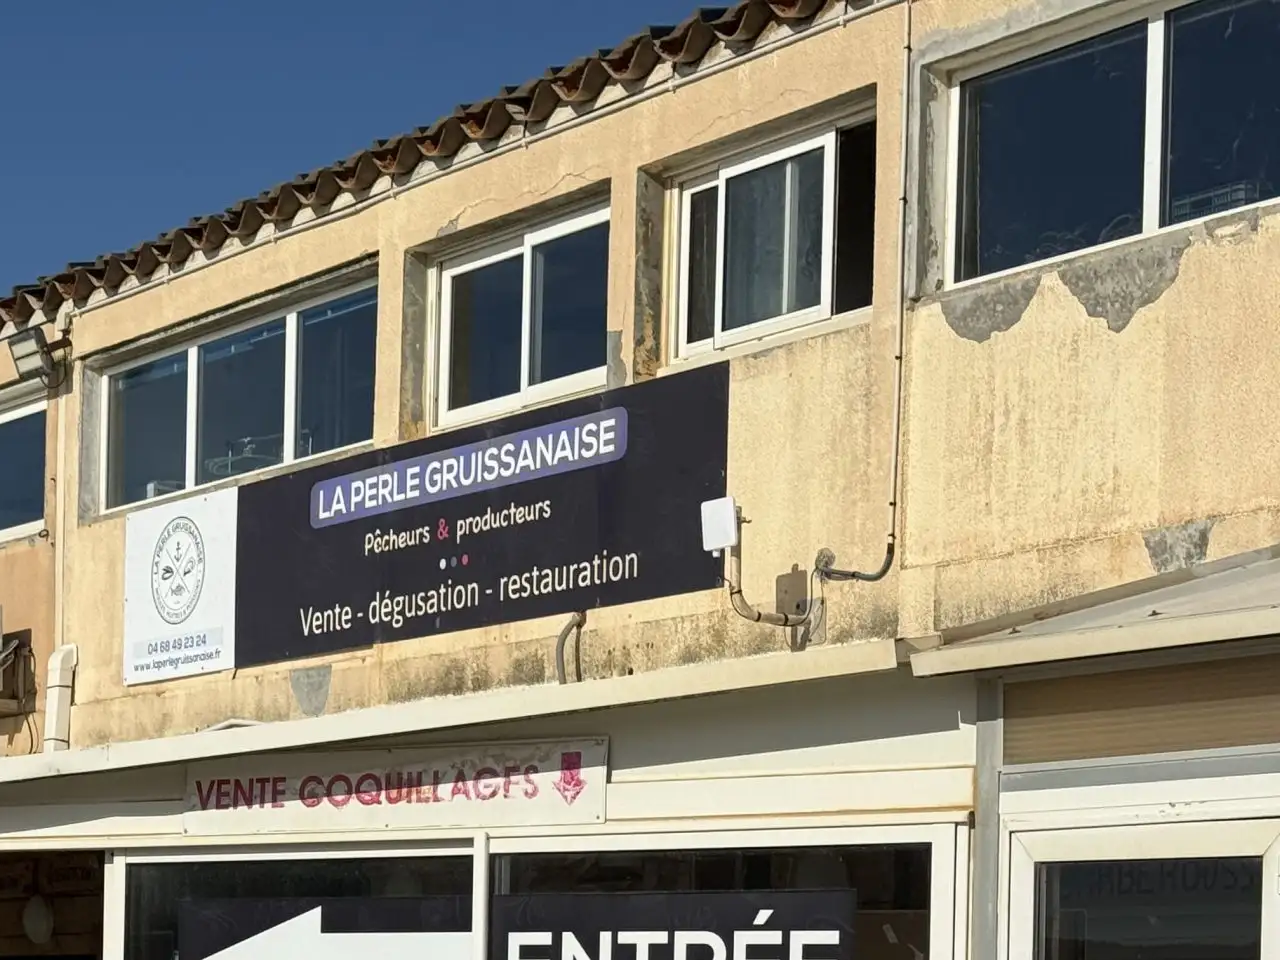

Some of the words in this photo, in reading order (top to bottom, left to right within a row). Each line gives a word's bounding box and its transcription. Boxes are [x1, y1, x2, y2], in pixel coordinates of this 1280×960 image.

[319, 484, 346, 519] LA
[350, 466, 420, 513] PERLE
[424, 418, 616, 495] GRUISSANAISE
[364, 523, 430, 556] Pêcheurs
[436, 518, 450, 540] &
[456, 498, 551, 544] producteurs
[299, 604, 352, 637] Vente
[368, 579, 479, 629] dégusation
[498, 549, 639, 601] restauration
[147, 642, 158, 655] 04
[172, 637, 182, 650] 49
[183, 635, 194, 649] 23
[195, 633, 206, 647] 24
[195, 776, 286, 811] VENTE
